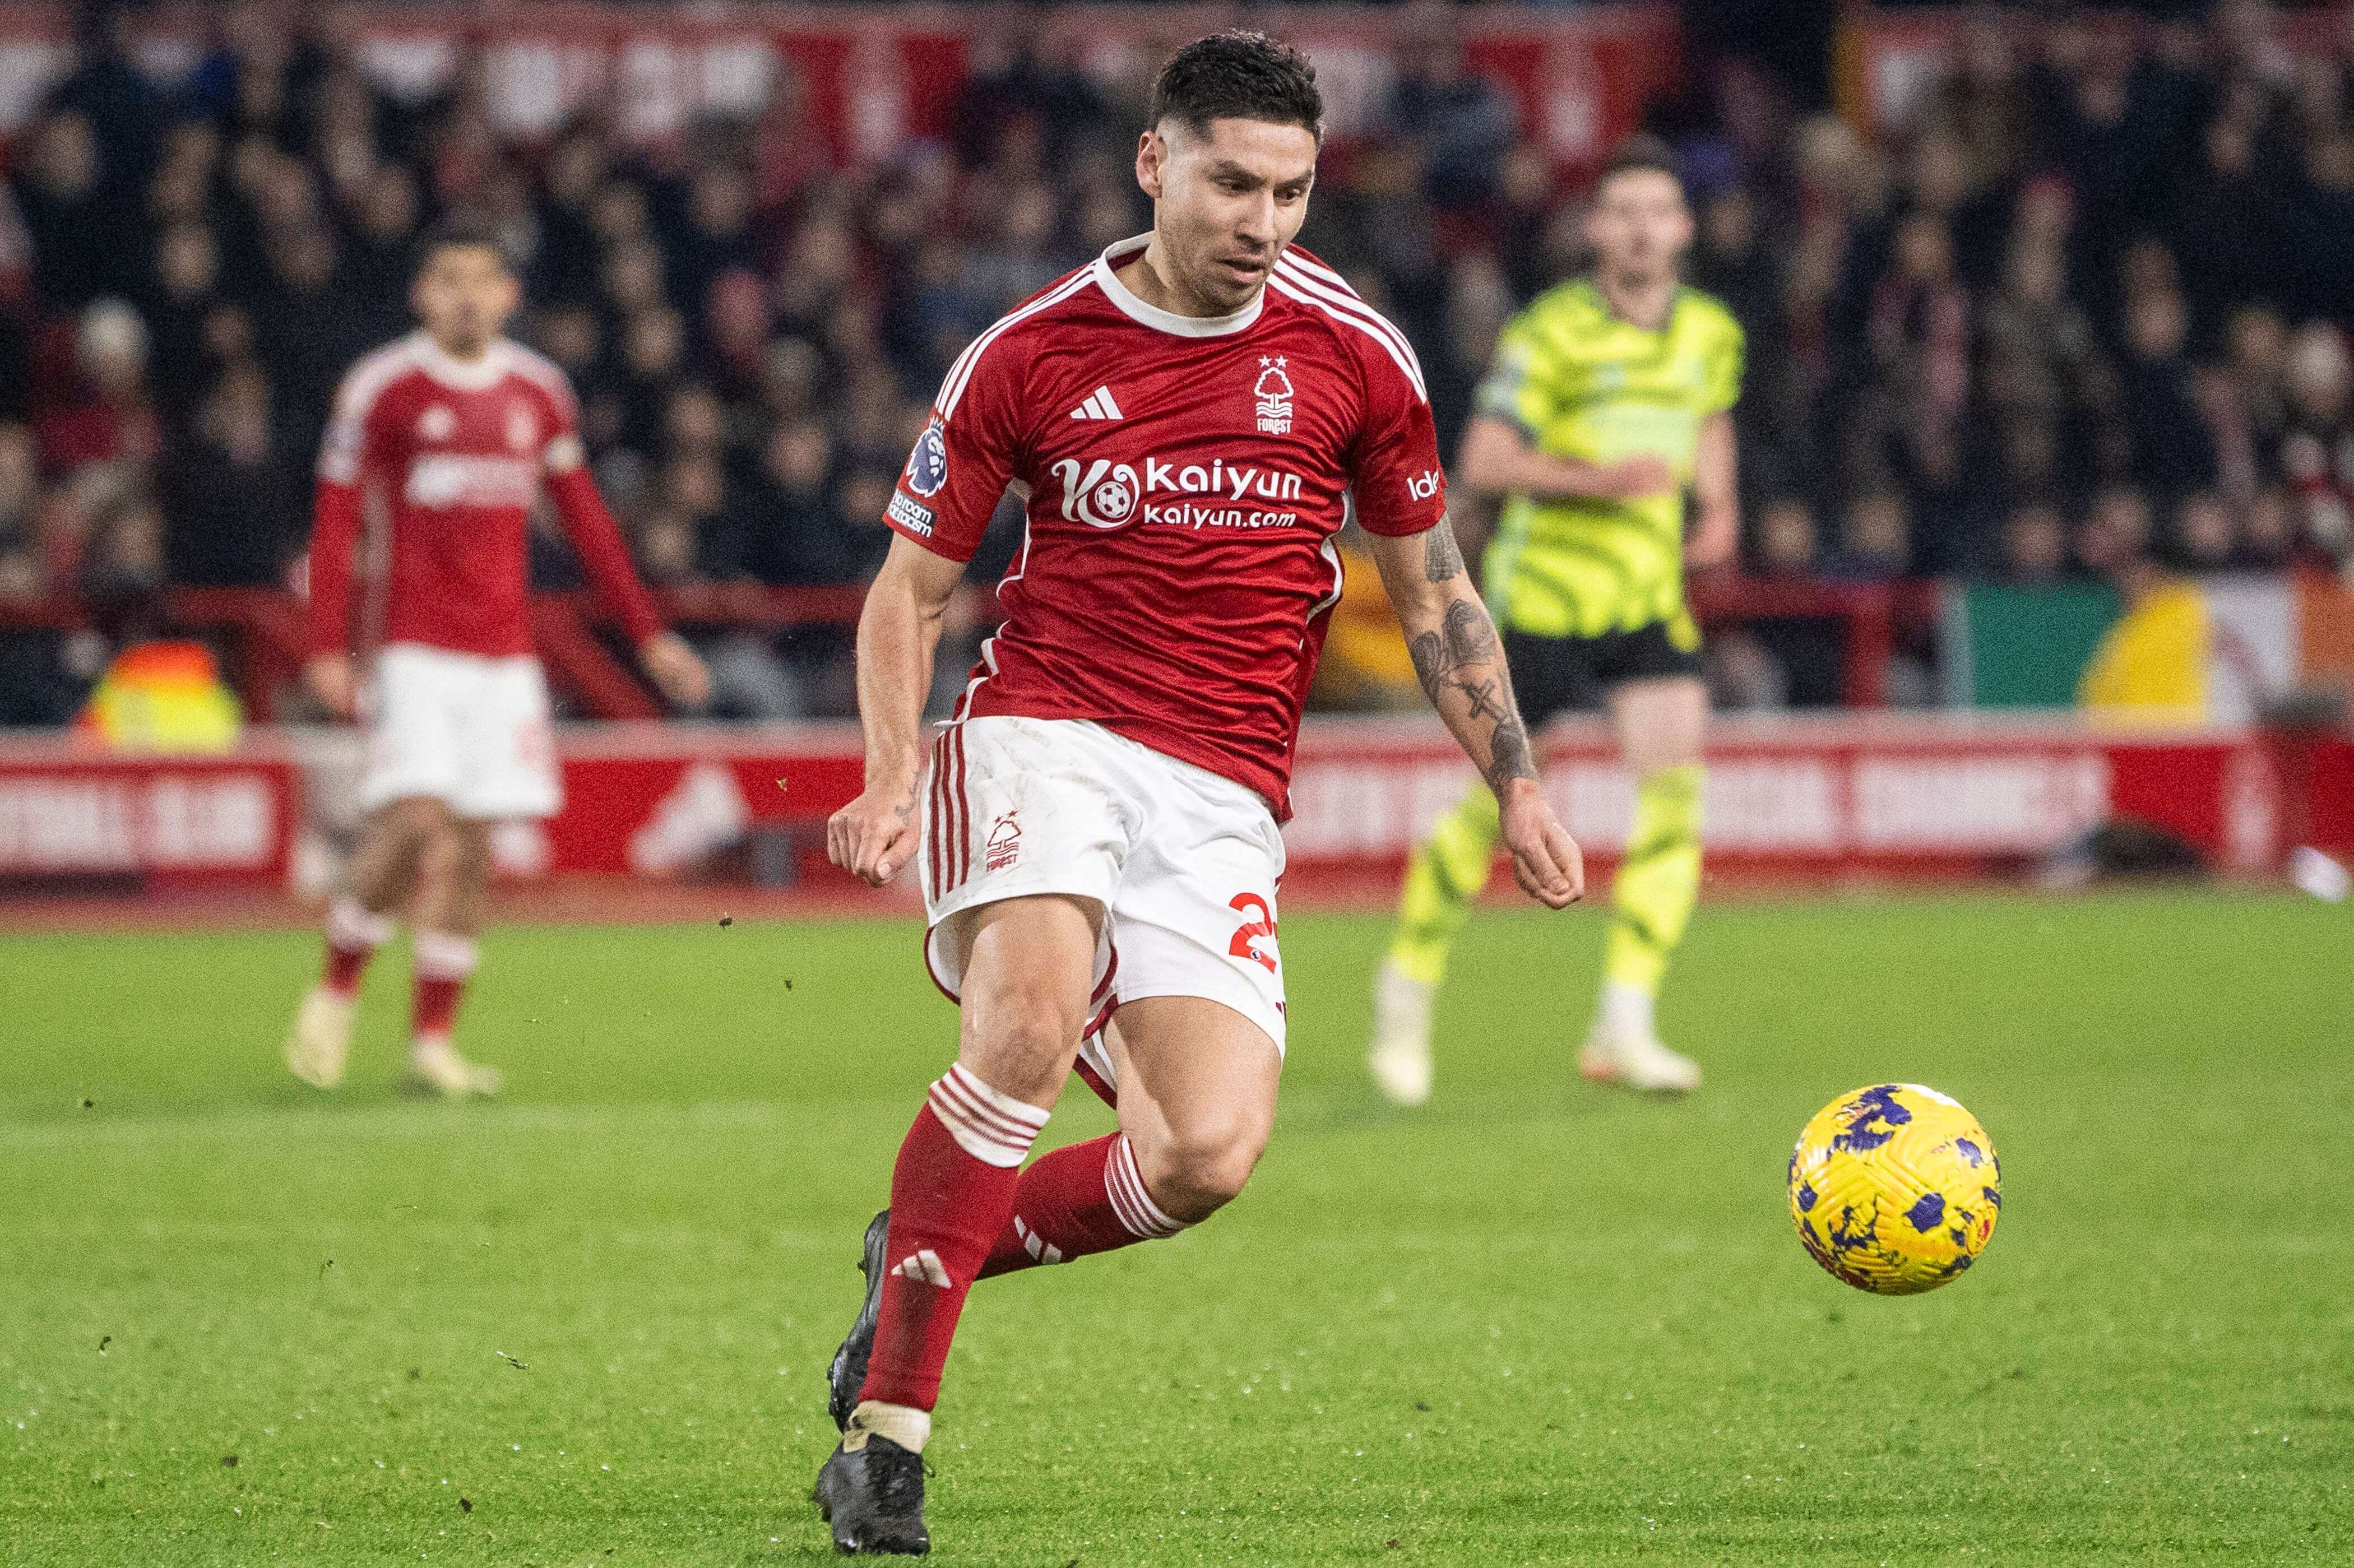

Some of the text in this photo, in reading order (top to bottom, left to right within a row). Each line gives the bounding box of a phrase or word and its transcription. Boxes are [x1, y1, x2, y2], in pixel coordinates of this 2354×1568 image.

[1257, 418, 1292, 435] FOREST
[1146, 457, 1302, 501] kaiyun
[901, 498, 932, 524] room
[1144, 503, 1296, 530] kaiyun.com
[1229, 892, 1278, 975] 2
